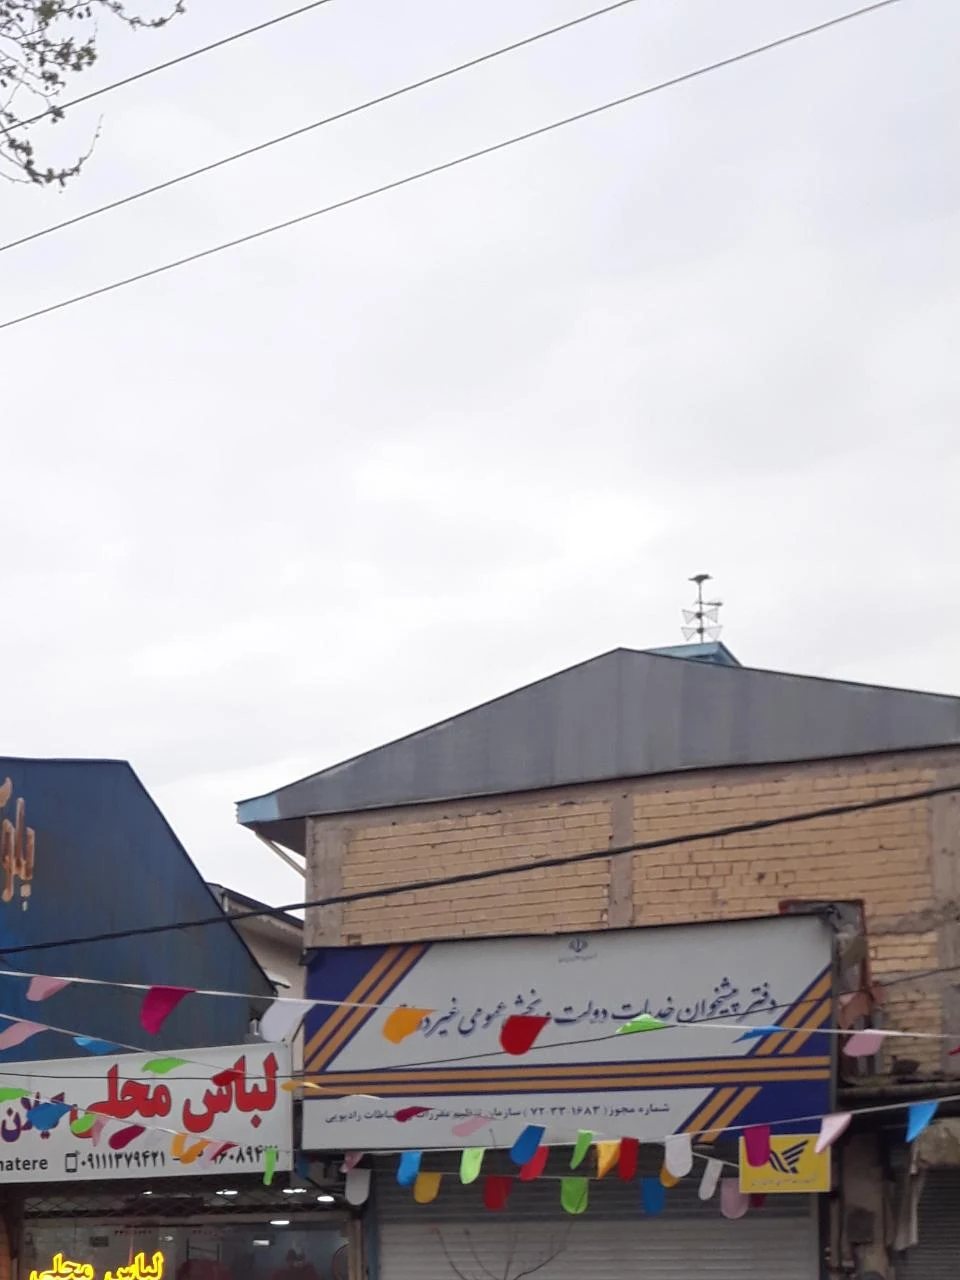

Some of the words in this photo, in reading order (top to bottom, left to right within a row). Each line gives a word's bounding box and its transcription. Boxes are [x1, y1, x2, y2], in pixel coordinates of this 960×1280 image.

[553, 1000, 608, 1024] دولت
[611, 995, 674, 1022] خدمات
[676, 976, 739, 1023] پیشخوان
[736, 982, 776, 1022] دفتر
[70, 1064, 172, 1139] محلی
[181, 1053, 280, 1134] لباس
[639, 1103, 669, 1116] شماره
[608, 1106, 633, 1117] مجوز
